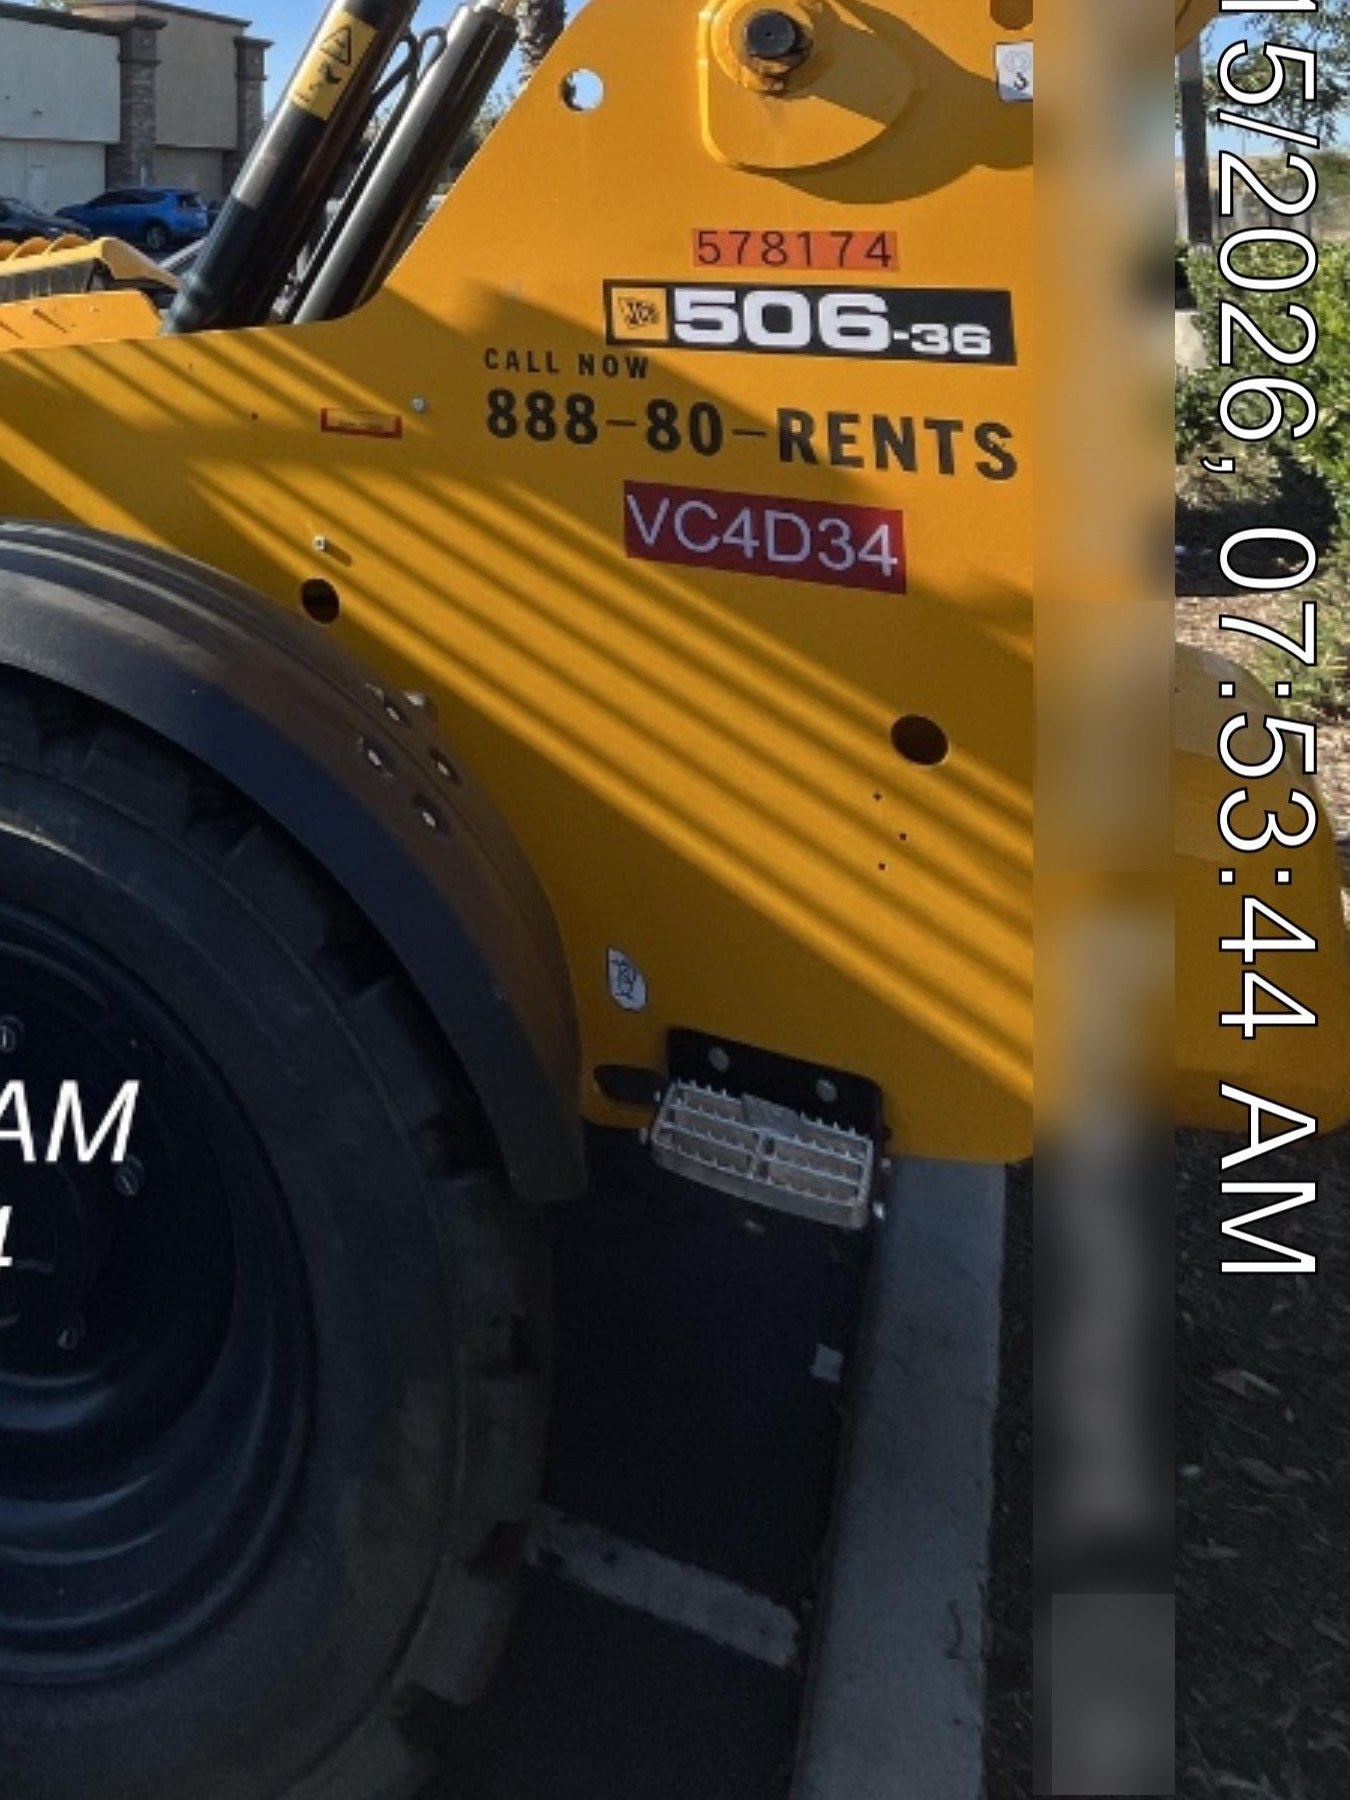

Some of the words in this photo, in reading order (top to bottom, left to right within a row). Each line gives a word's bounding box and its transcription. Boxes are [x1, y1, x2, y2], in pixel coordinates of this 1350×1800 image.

[696, 230, 893, 268] 578174
[674, 288, 992, 356] 506-36
[484, 348, 560, 373] CALL
[578, 353, 648, 379] NOW
[487, 388, 1018, 481] 888-80-RENTS
[626, 494, 899, 578] VC4D34
